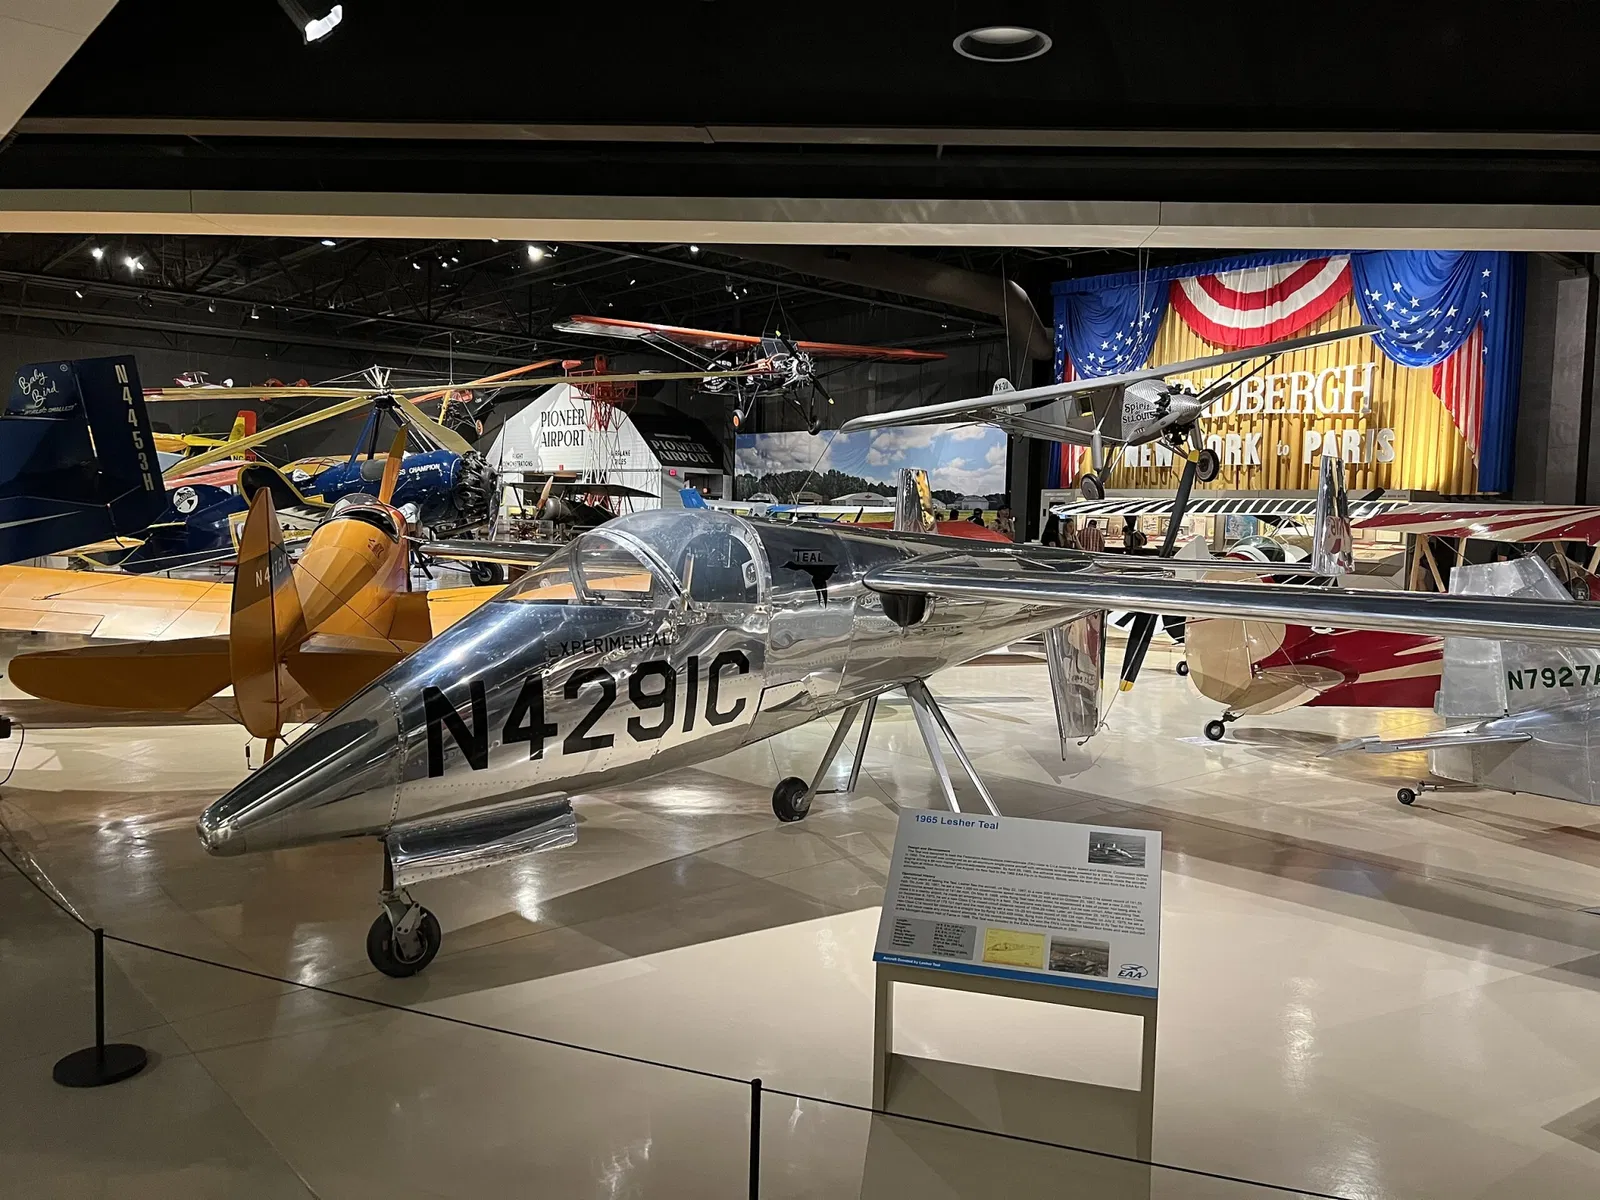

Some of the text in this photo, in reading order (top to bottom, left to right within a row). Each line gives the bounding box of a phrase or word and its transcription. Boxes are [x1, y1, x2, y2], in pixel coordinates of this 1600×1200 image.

[18, 368, 48, 395] Baby
[31, 380, 60, 408] Bird
[1124, 402, 1150, 414] Spirit
[540, 408, 585, 428] PIONEER
[114, 364, 155, 491] N4453H
[540, 429, 586, 448] AIRPORT
[650, 439, 709, 454] PIONEER
[1124, 444, 1174, 467] NEW
[1276, 440, 1290, 456] to
[1304, 428, 1395, 464] PARIS
[658, 450, 715, 464] AIRPORT
[408, 463, 440, 474] CHAMPION
[792, 548, 824, 563] TEAL
[546, 630, 674, 659] EXPERIMENTAL
[915, 814, 999, 830] 1965 Lesher Teal
[1117, 970, 1142, 979] EAA
